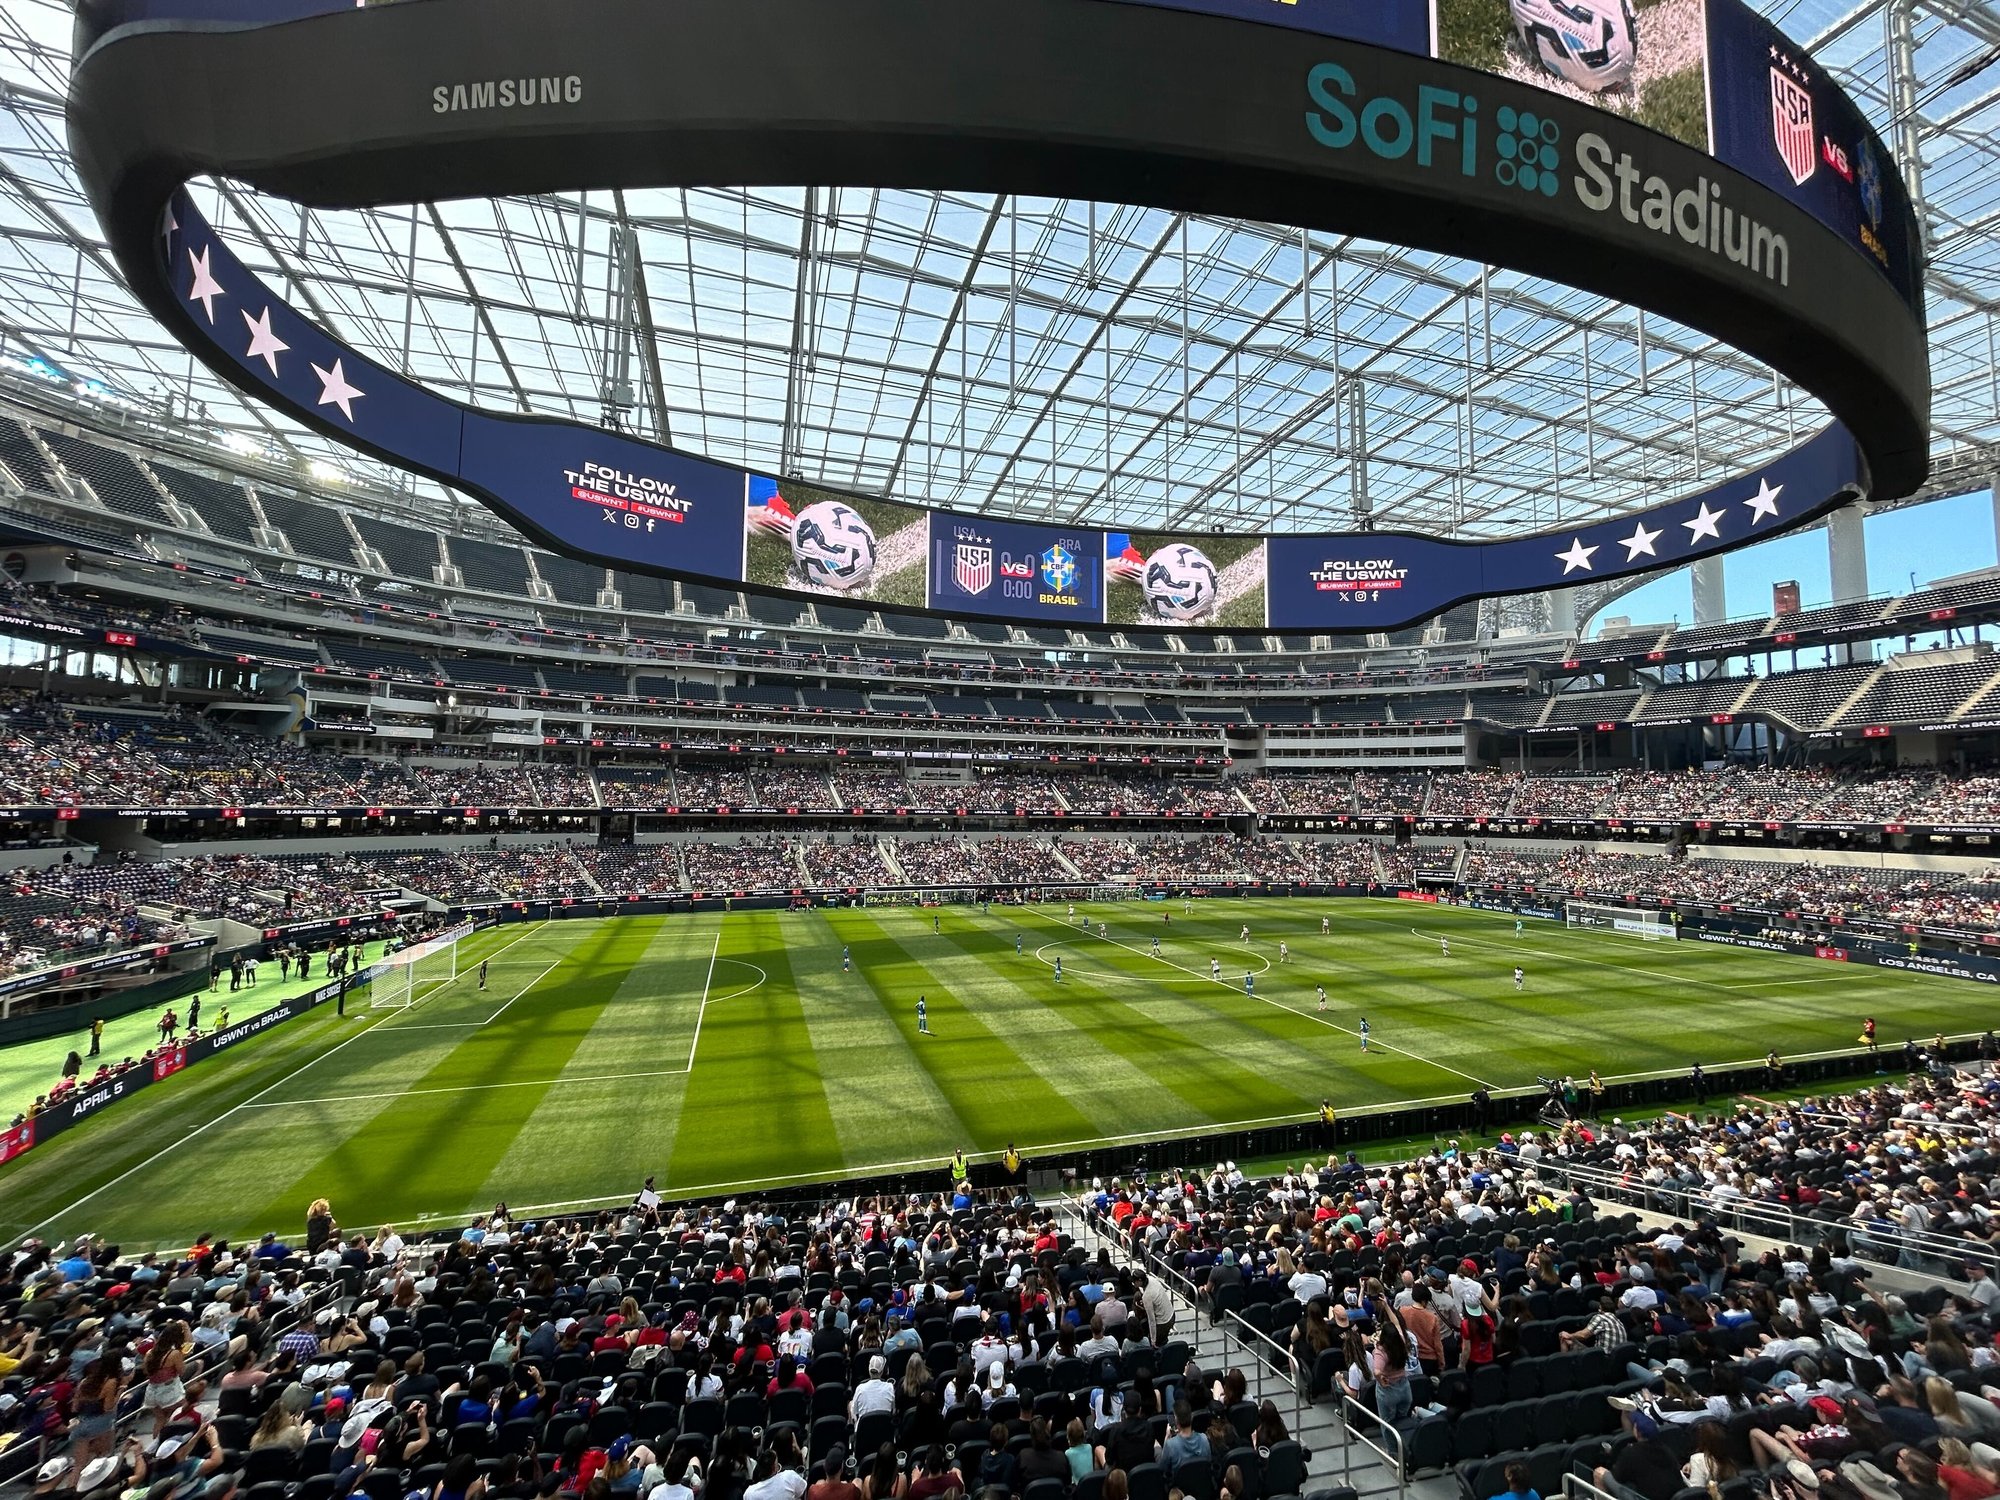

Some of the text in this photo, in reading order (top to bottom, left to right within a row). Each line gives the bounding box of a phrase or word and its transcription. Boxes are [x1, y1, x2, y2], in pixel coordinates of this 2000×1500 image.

[433, 76, 581, 113] SAMSUNG
[1774, 74, 1809, 125] USA
[1306, 62, 1788, 287] SoFi Stadium
[584, 461, 676, 496] FOLLOW
[563, 469, 692, 513] THE USWNT
[577, 491, 624, 507] @USWNT
[637, 505, 678, 520] #USWNT
[953, 526, 976, 538] USA
[1058, 539, 1081, 551] BRA
[960, 547, 989, 566] USA
[1003, 563, 1028, 574] VS
[1323, 560, 1393, 571] FOLLOW
[1309, 569, 1408, 581] THE USWNT
[1003, 580, 1032, 599] 0:00
[1040, 594, 1078, 606] BRASIL
[46, 624, 84, 635] BRAZIL
[1822, 626, 1840, 634] LOS
[1885, 618, 1897, 626] CA
[1687, 644, 1713, 653] USWNT
[1722, 640, 1748, 649] BRAZIL
[1809, 731, 1833, 739] APRIL
[1919, 723, 1957, 731] USWNT
[1521, 908, 1554, 918] Volkswagen
[1699, 934, 1735, 944] USWNT
[1749, 941, 1787, 951] BRAZIL
[1879, 958, 1997, 982] LOS ANGELES, CA
[213, 1006, 291, 1048] USWNT vs BRAZIL
[72, 1081, 124, 1117] APRIL 5
